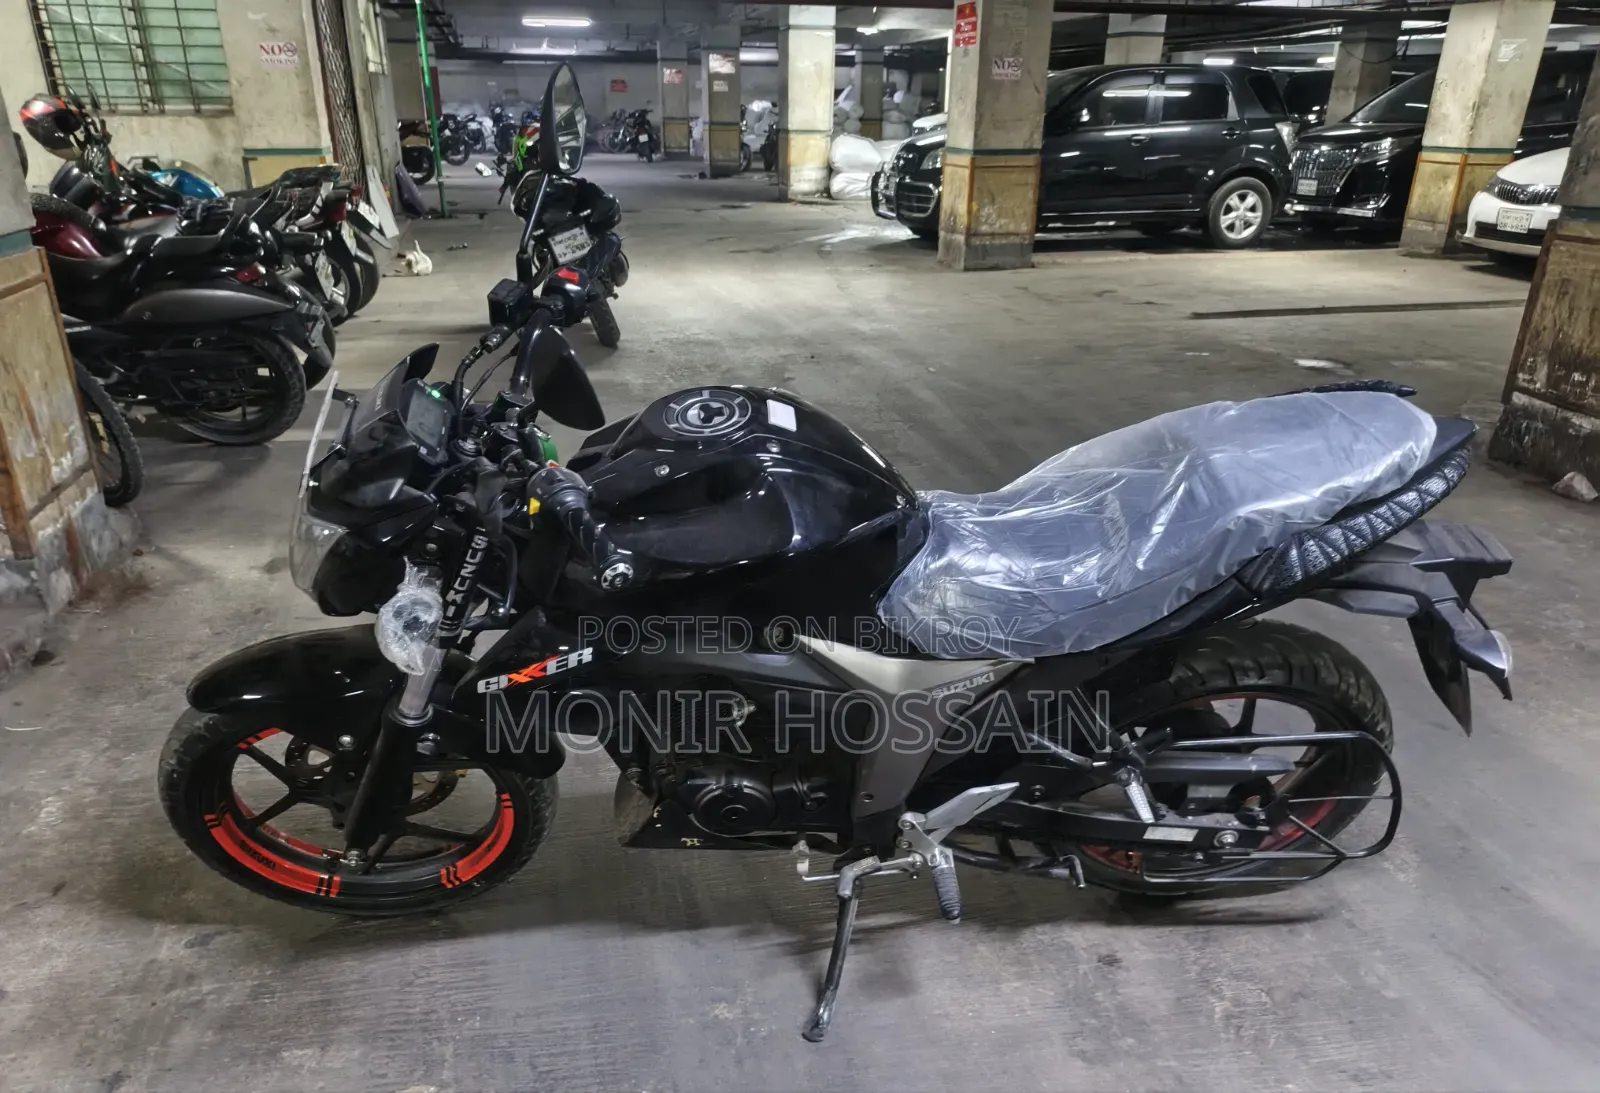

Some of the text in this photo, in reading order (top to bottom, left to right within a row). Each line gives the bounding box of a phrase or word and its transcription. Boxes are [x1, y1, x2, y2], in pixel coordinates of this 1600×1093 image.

[259, 44, 282, 56] NO
[993, 60, 1010, 70] NO
[477, 647, 593, 693] GIXXER
[931, 672, 995, 699] SUZUKI
